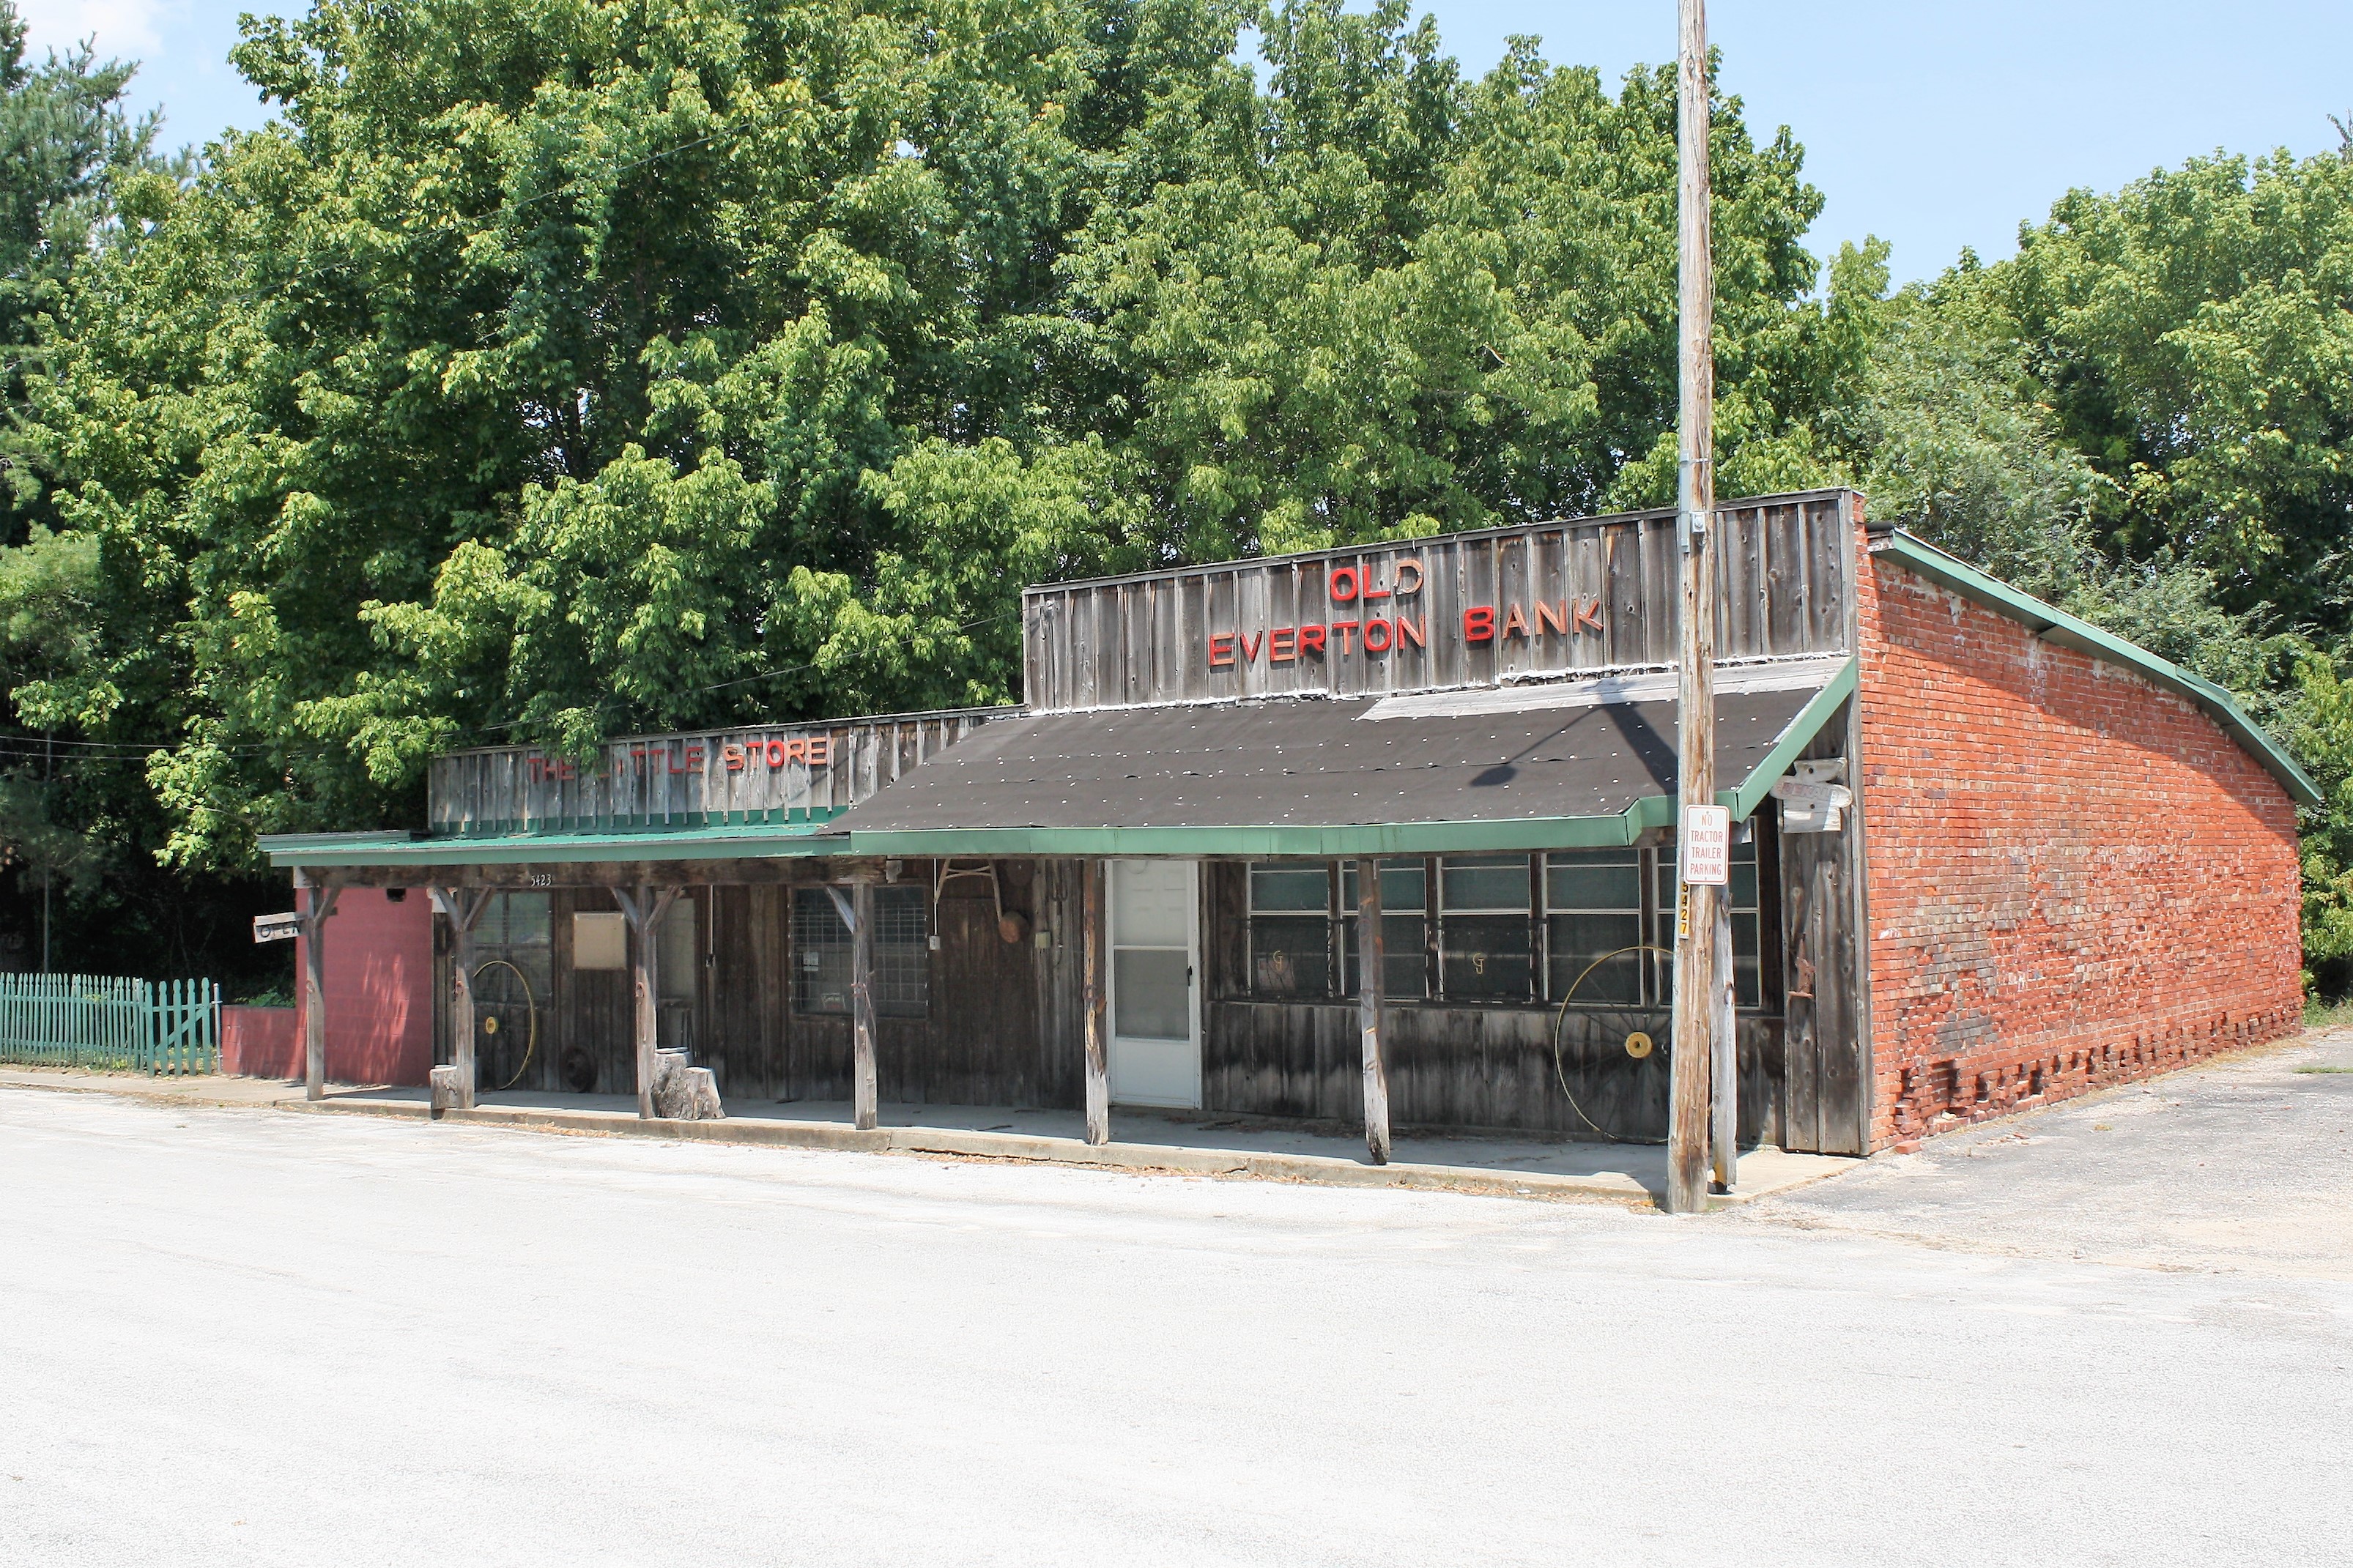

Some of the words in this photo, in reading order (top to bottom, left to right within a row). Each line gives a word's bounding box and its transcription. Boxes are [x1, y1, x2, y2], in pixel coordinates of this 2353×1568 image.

[1330, 559, 1424, 601] OLD
[1209, 614, 1426, 666] EVERTON
[1464, 599, 1603, 642] BANK
[527, 756, 575, 783] THE
[596, 746, 704, 779] ITTLE
[724, 736, 827, 770] STORE
[1701, 814, 1713, 826] NO
[1691, 830, 1723, 843] TRACTOR
[1691, 847, 1722, 859] TRAILER
[1690, 863, 1722, 875] PARKING
[1681, 881, 1689, 935] 5427
